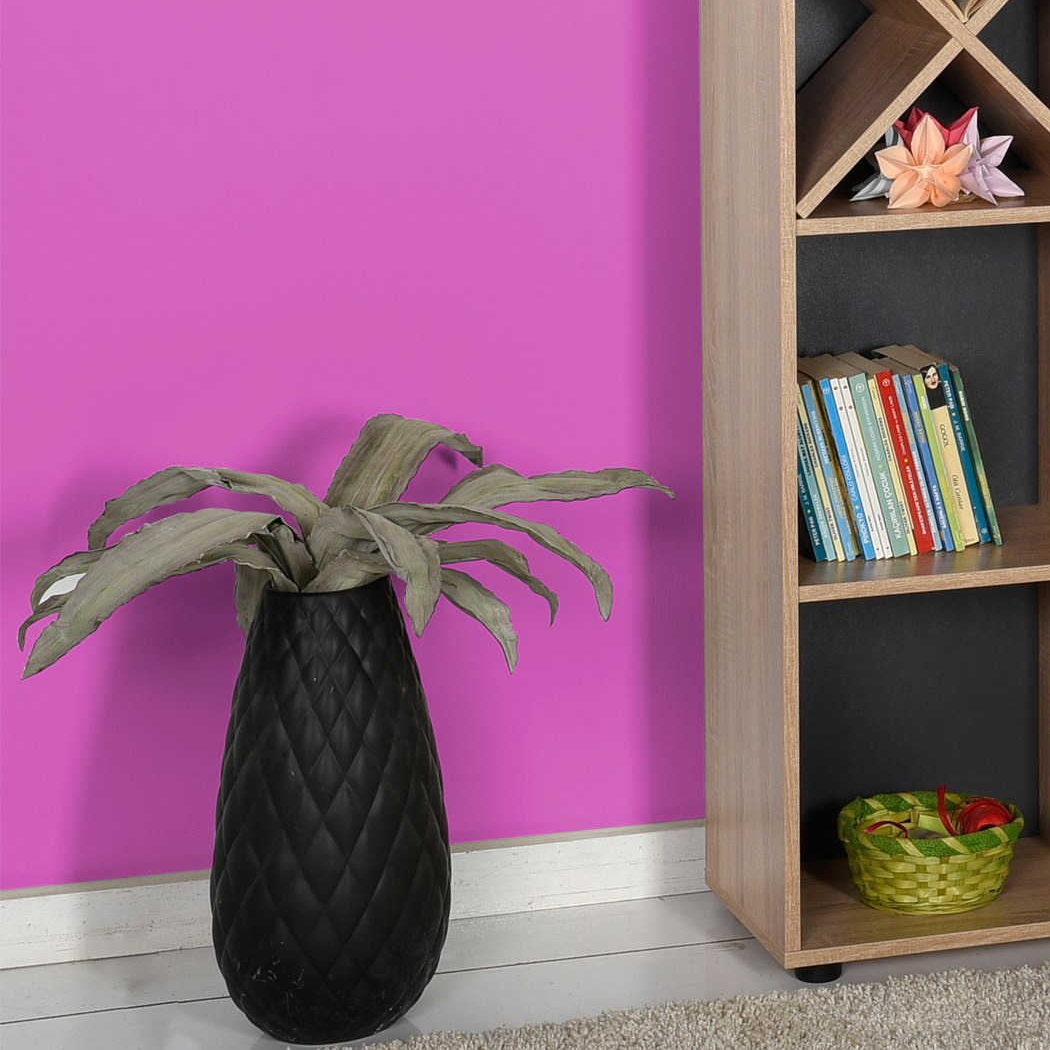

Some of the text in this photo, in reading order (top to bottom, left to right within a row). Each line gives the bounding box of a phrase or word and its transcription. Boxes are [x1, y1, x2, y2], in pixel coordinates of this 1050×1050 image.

[943, 380, 952, 398] PETER
[804, 422, 819, 468] CHARLES DICKENS
[878, 417, 893, 462] CHARLES DICKENS
[939, 424, 950, 448] GOGOL
[841, 454, 858, 501] CARLO COLLODI
[879, 470, 892, 498] ÇOCUK
[954, 487, 965, 511] Canlar
[830, 522, 838, 541] OLIVER
[886, 498, 902, 539] KAÇIRILAN
[811, 528, 821, 546] PETER
